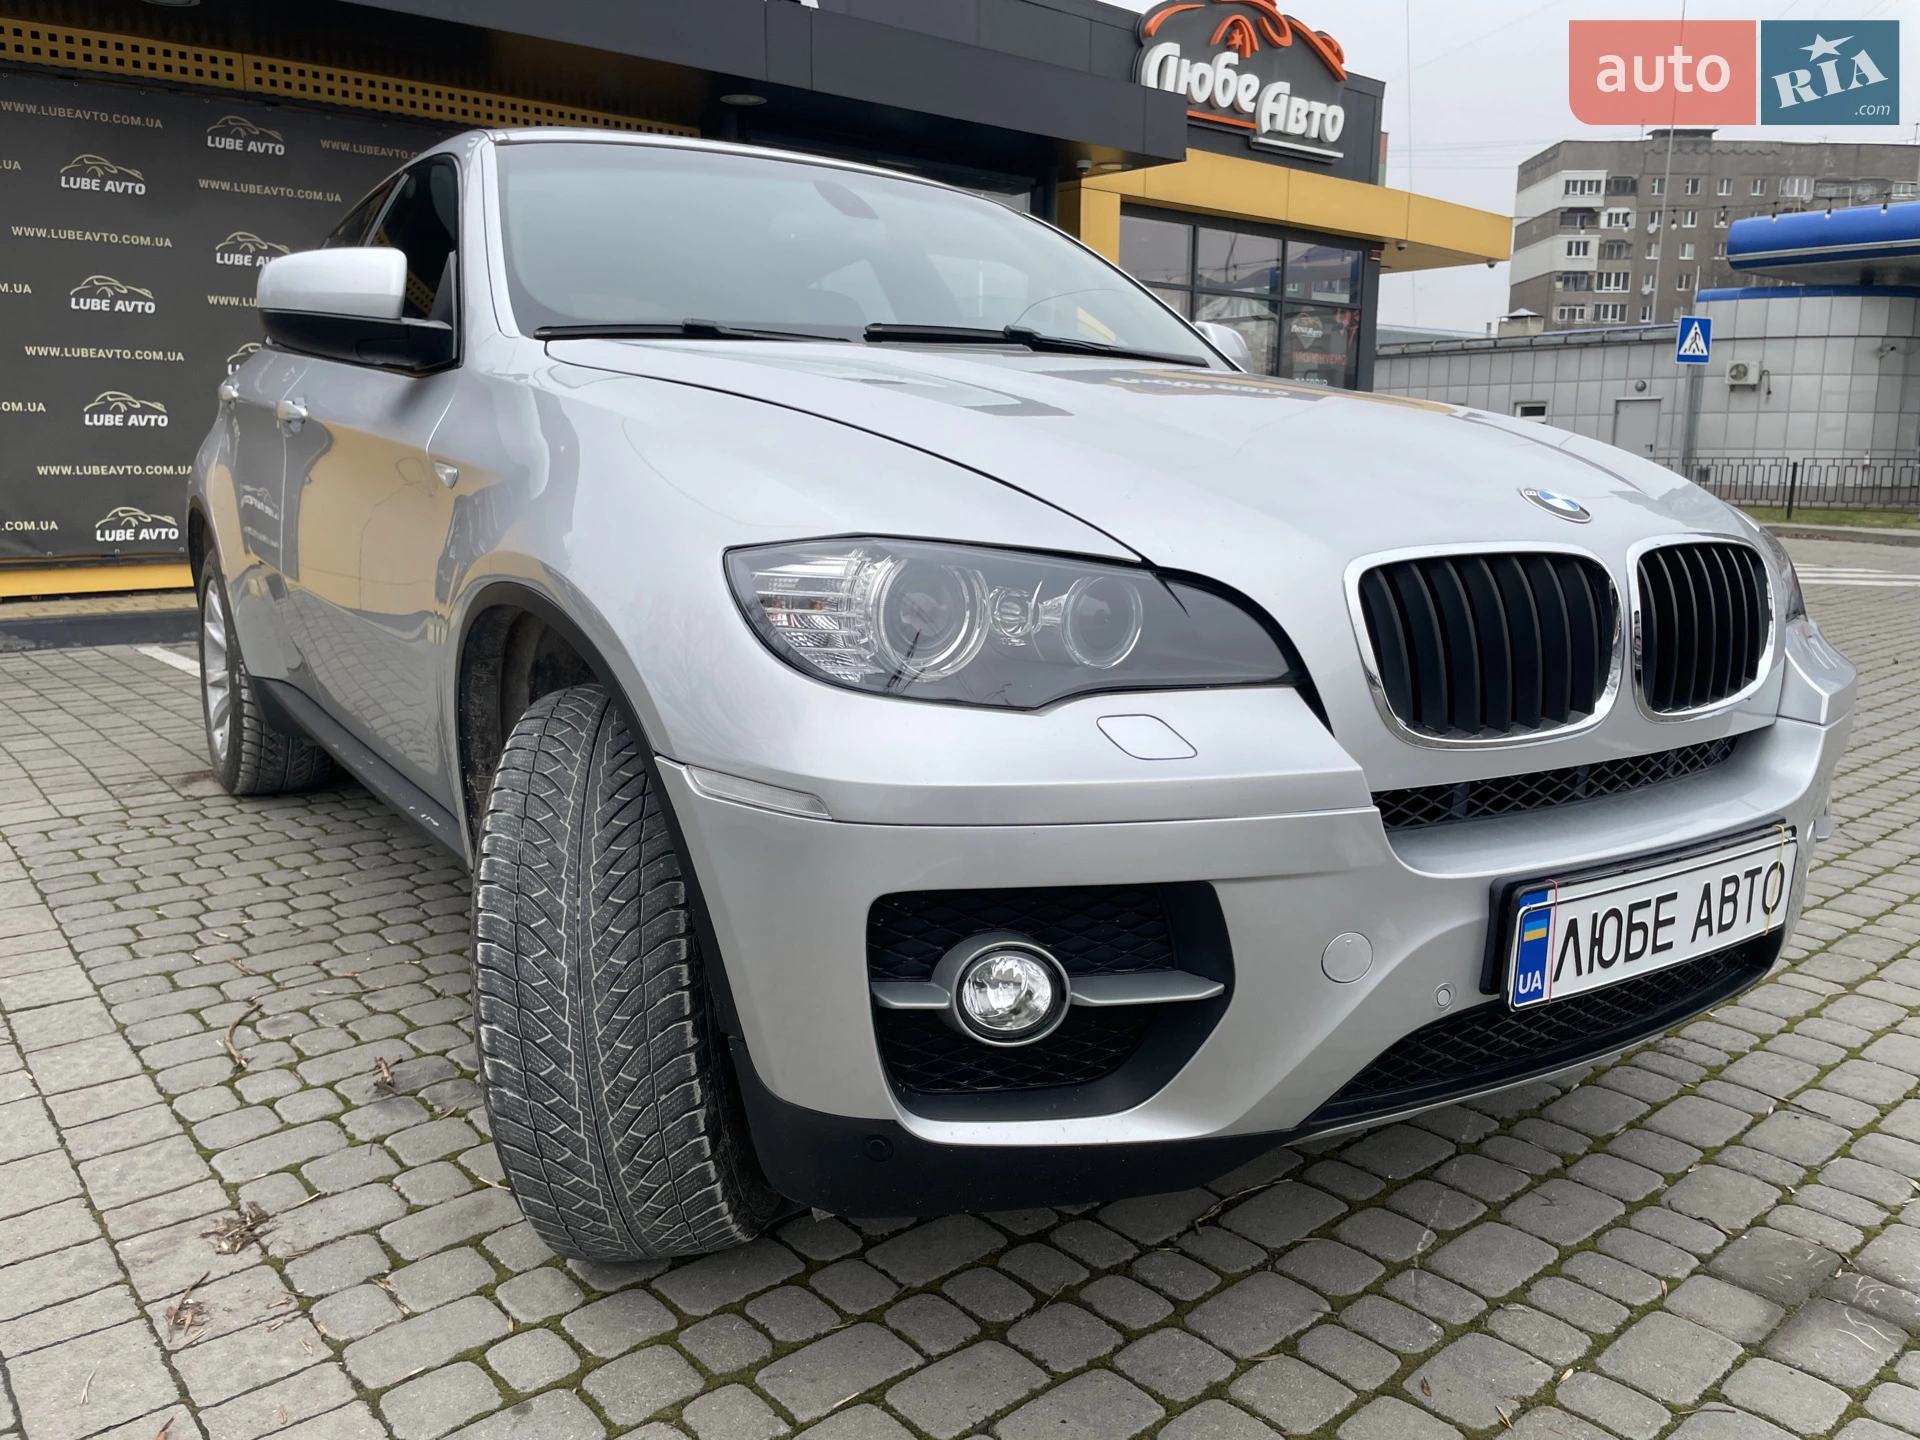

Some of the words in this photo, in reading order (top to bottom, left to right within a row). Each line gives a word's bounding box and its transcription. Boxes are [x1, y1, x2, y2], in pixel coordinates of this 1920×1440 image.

[0, 100, 163, 129] WWW.LUBEAVTO.COM.UA
[207, 135, 244, 152] LUBE
[247, 139, 286, 156] AVTO
[60, 175, 101, 191] LUBE
[104, 179, 146, 196] AVTO
[198, 178, 343, 203] WWW.LUBEAVTO.COM.UA
[11, 225, 173, 249] WWW.LUBEAVTO.COM.UA
[215, 252, 252, 267] LUBE
[70, 297, 111, 312] LUBE
[114, 299, 156, 314] AVTO
[24, 345, 185, 362] WWW.LUBEAVTO.COM.UA
[84, 413, 124, 427] LUBE
[127, 414, 168, 428] AVTO
[37, 464, 193, 477] WWW.LUBEAVTO.COM.UA
[96, 528, 135, 542] LUBE
[139, 527, 179, 541] AVTO
[1553, 891, 1679, 983] ЛЮБЕ
[1690, 860, 1786, 944] АВТО
[1518, 969, 1543, 995] UA
